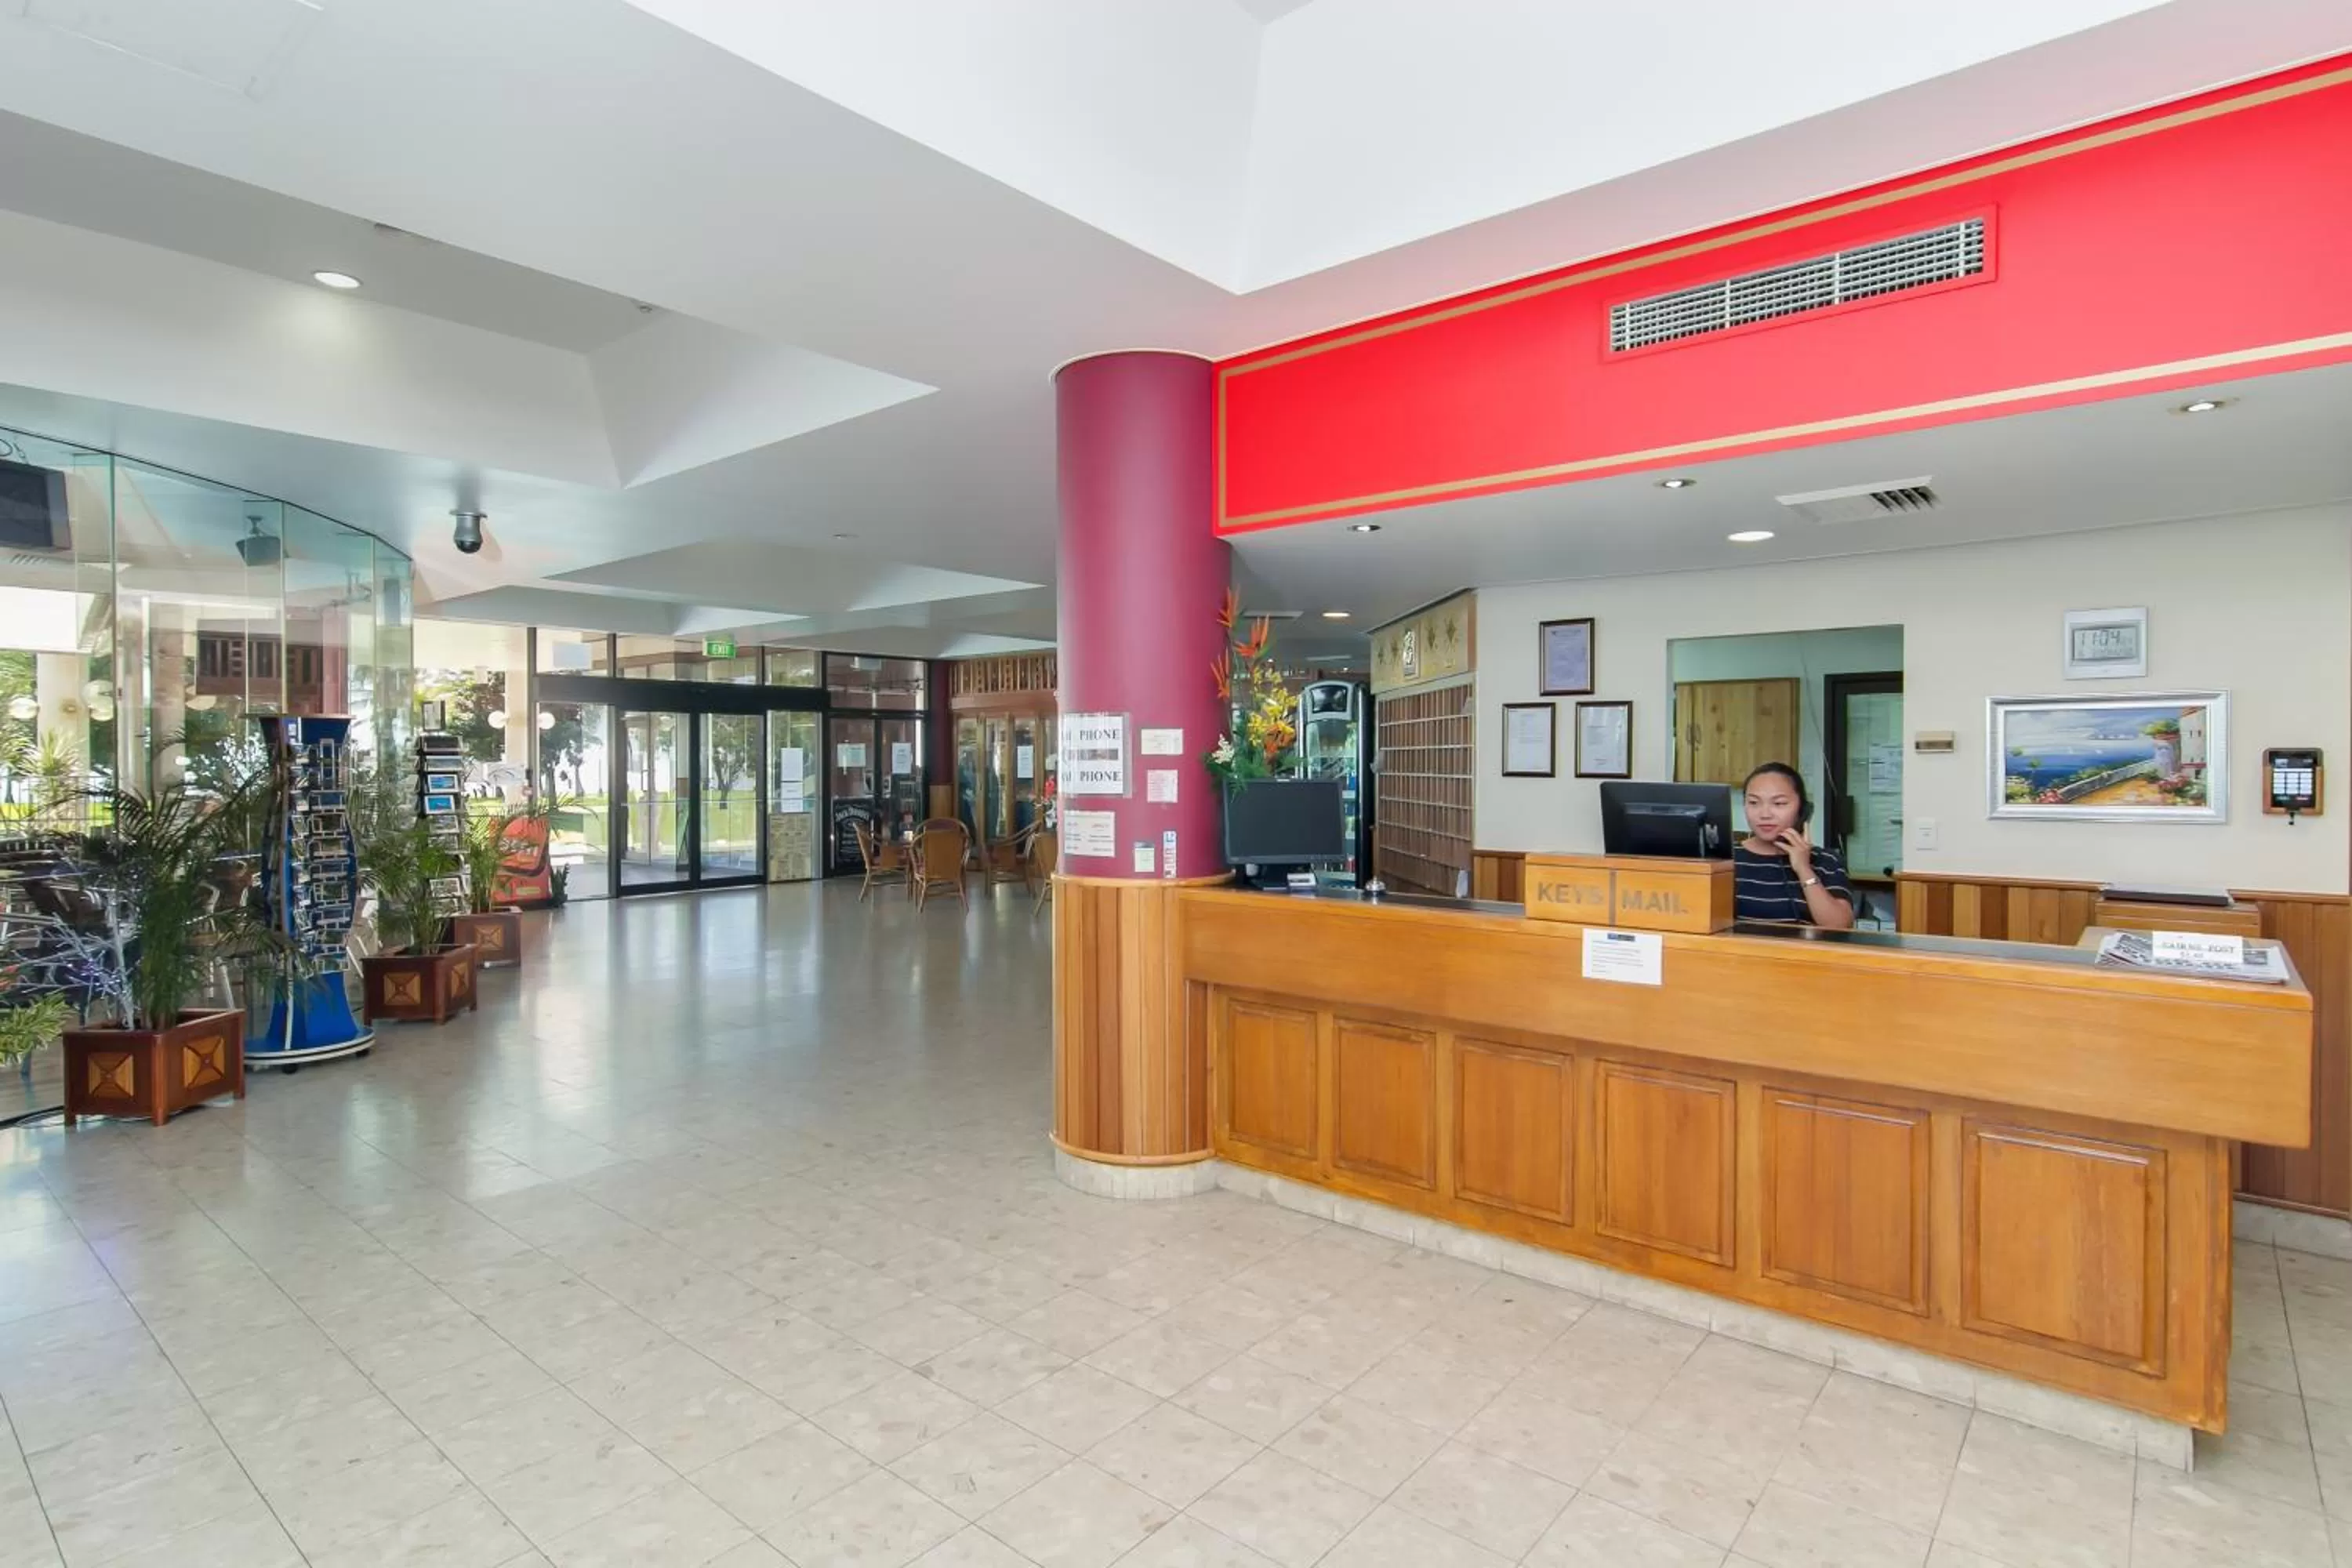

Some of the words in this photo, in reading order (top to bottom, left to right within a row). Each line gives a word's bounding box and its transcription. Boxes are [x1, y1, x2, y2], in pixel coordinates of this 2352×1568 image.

[712, 644, 730, 654] EXIT
[1080, 728, 1121, 741] PHONE
[1080, 771, 1122, 782] PHONE
[1537, 881, 1603, 904] KEYS
[1621, 889, 1688, 915] MAIL
